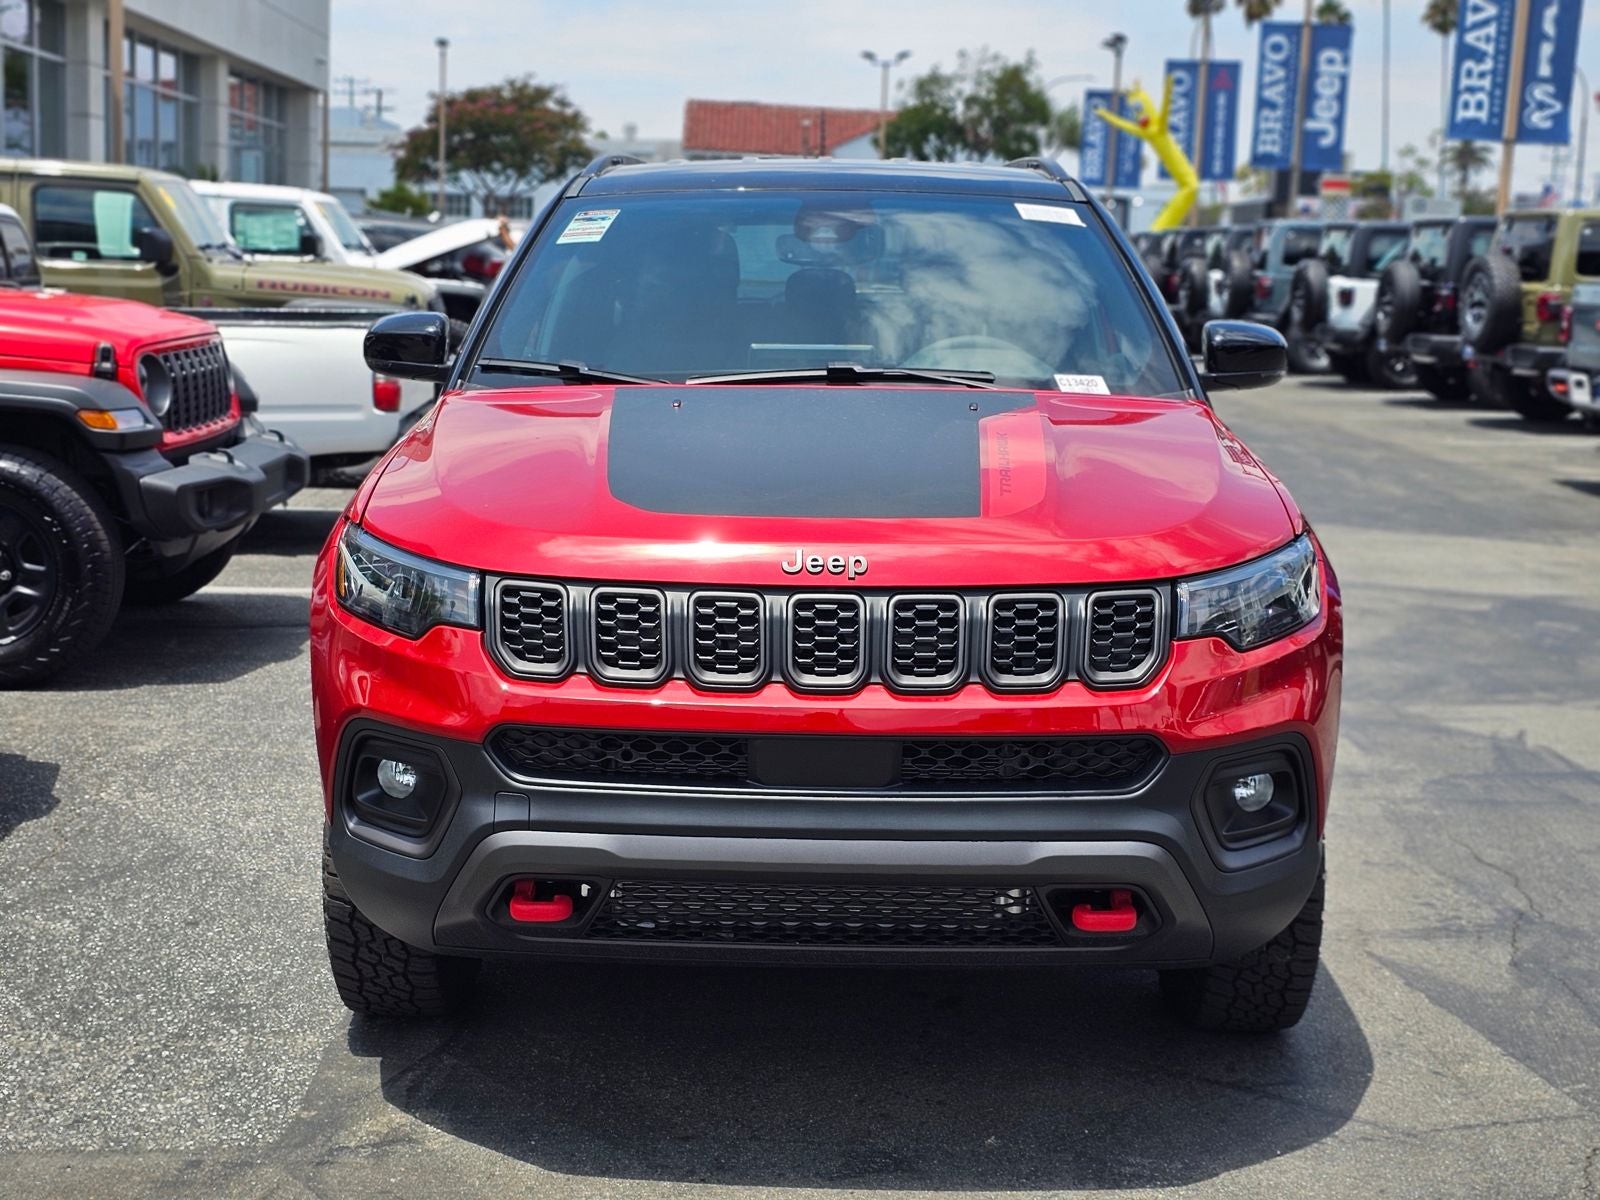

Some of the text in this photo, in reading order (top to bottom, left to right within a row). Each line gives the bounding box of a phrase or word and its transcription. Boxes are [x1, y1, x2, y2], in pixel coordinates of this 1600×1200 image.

[1257, 33, 1290, 155] BRAVO
[1304, 47, 1349, 148] Jeep
[257, 279, 391, 299] RUBICON
[995, 431, 1012, 496] TRAILHAWK
[781, 548, 868, 580] Jeep
